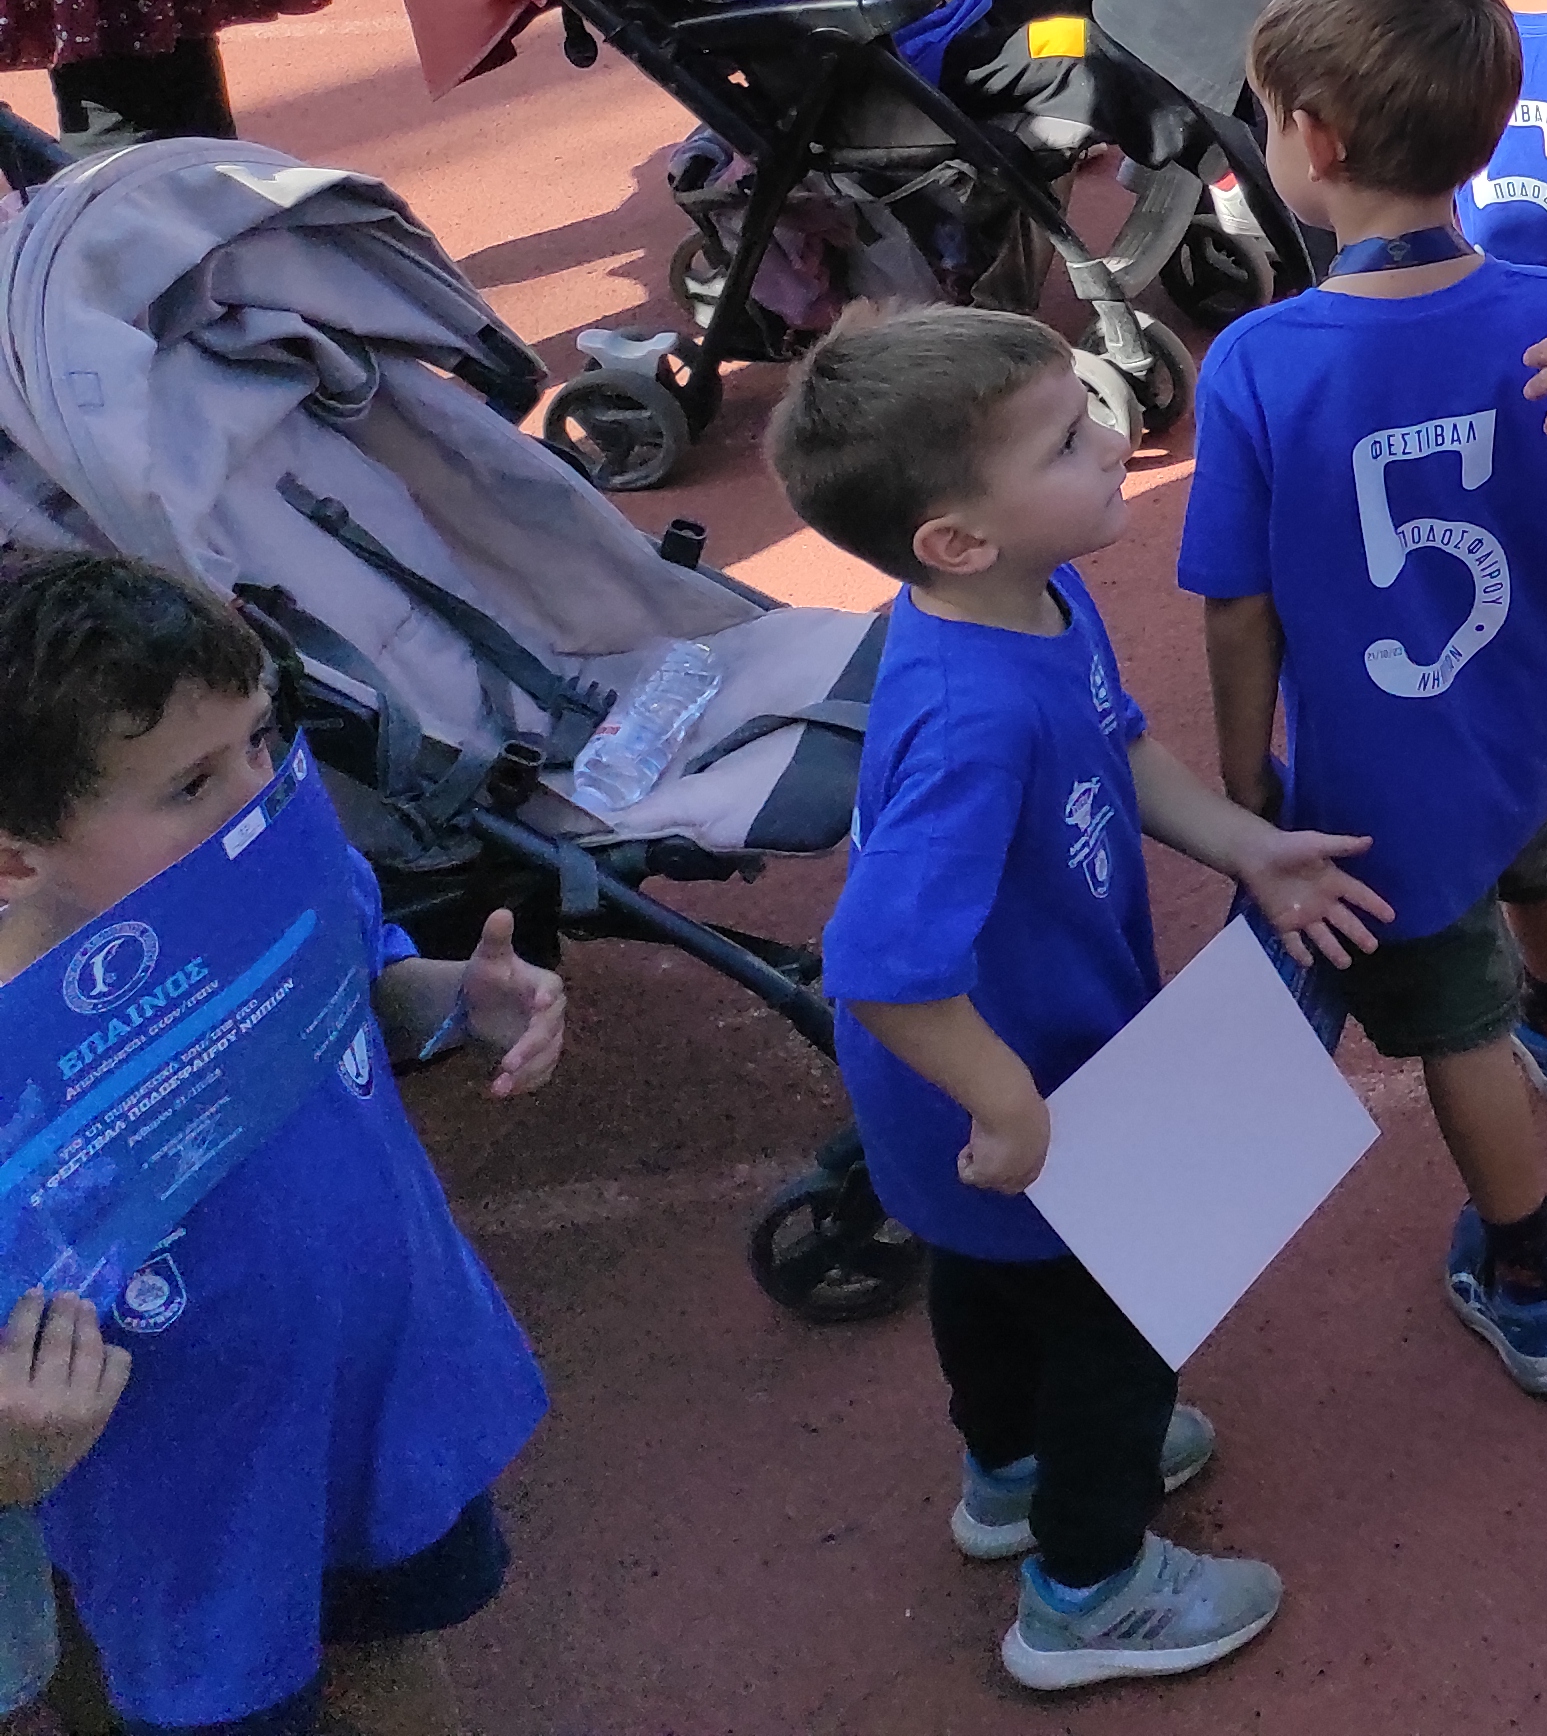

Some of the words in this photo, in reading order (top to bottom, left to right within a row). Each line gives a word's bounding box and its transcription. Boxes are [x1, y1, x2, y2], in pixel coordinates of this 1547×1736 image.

[1370, 420, 1477, 460] ΦΕΣΤΙΒΑΛ
[1352, 408, 1512, 698] 5
[1398, 524, 1504, 605] ΠΟΔΟΣΦΑΙΡΟΥ
[1416, 645, 1463, 692] ΝΗΩΝ
[57, 956, 209, 1080] ΕΠΑΙΝΟΣ
[127, 1029, 238, 1121] ΠΟΔΟΣΦΑΙΡΟΥ
[238, 976, 295, 1034] ΝΗΠΙΩΝ
